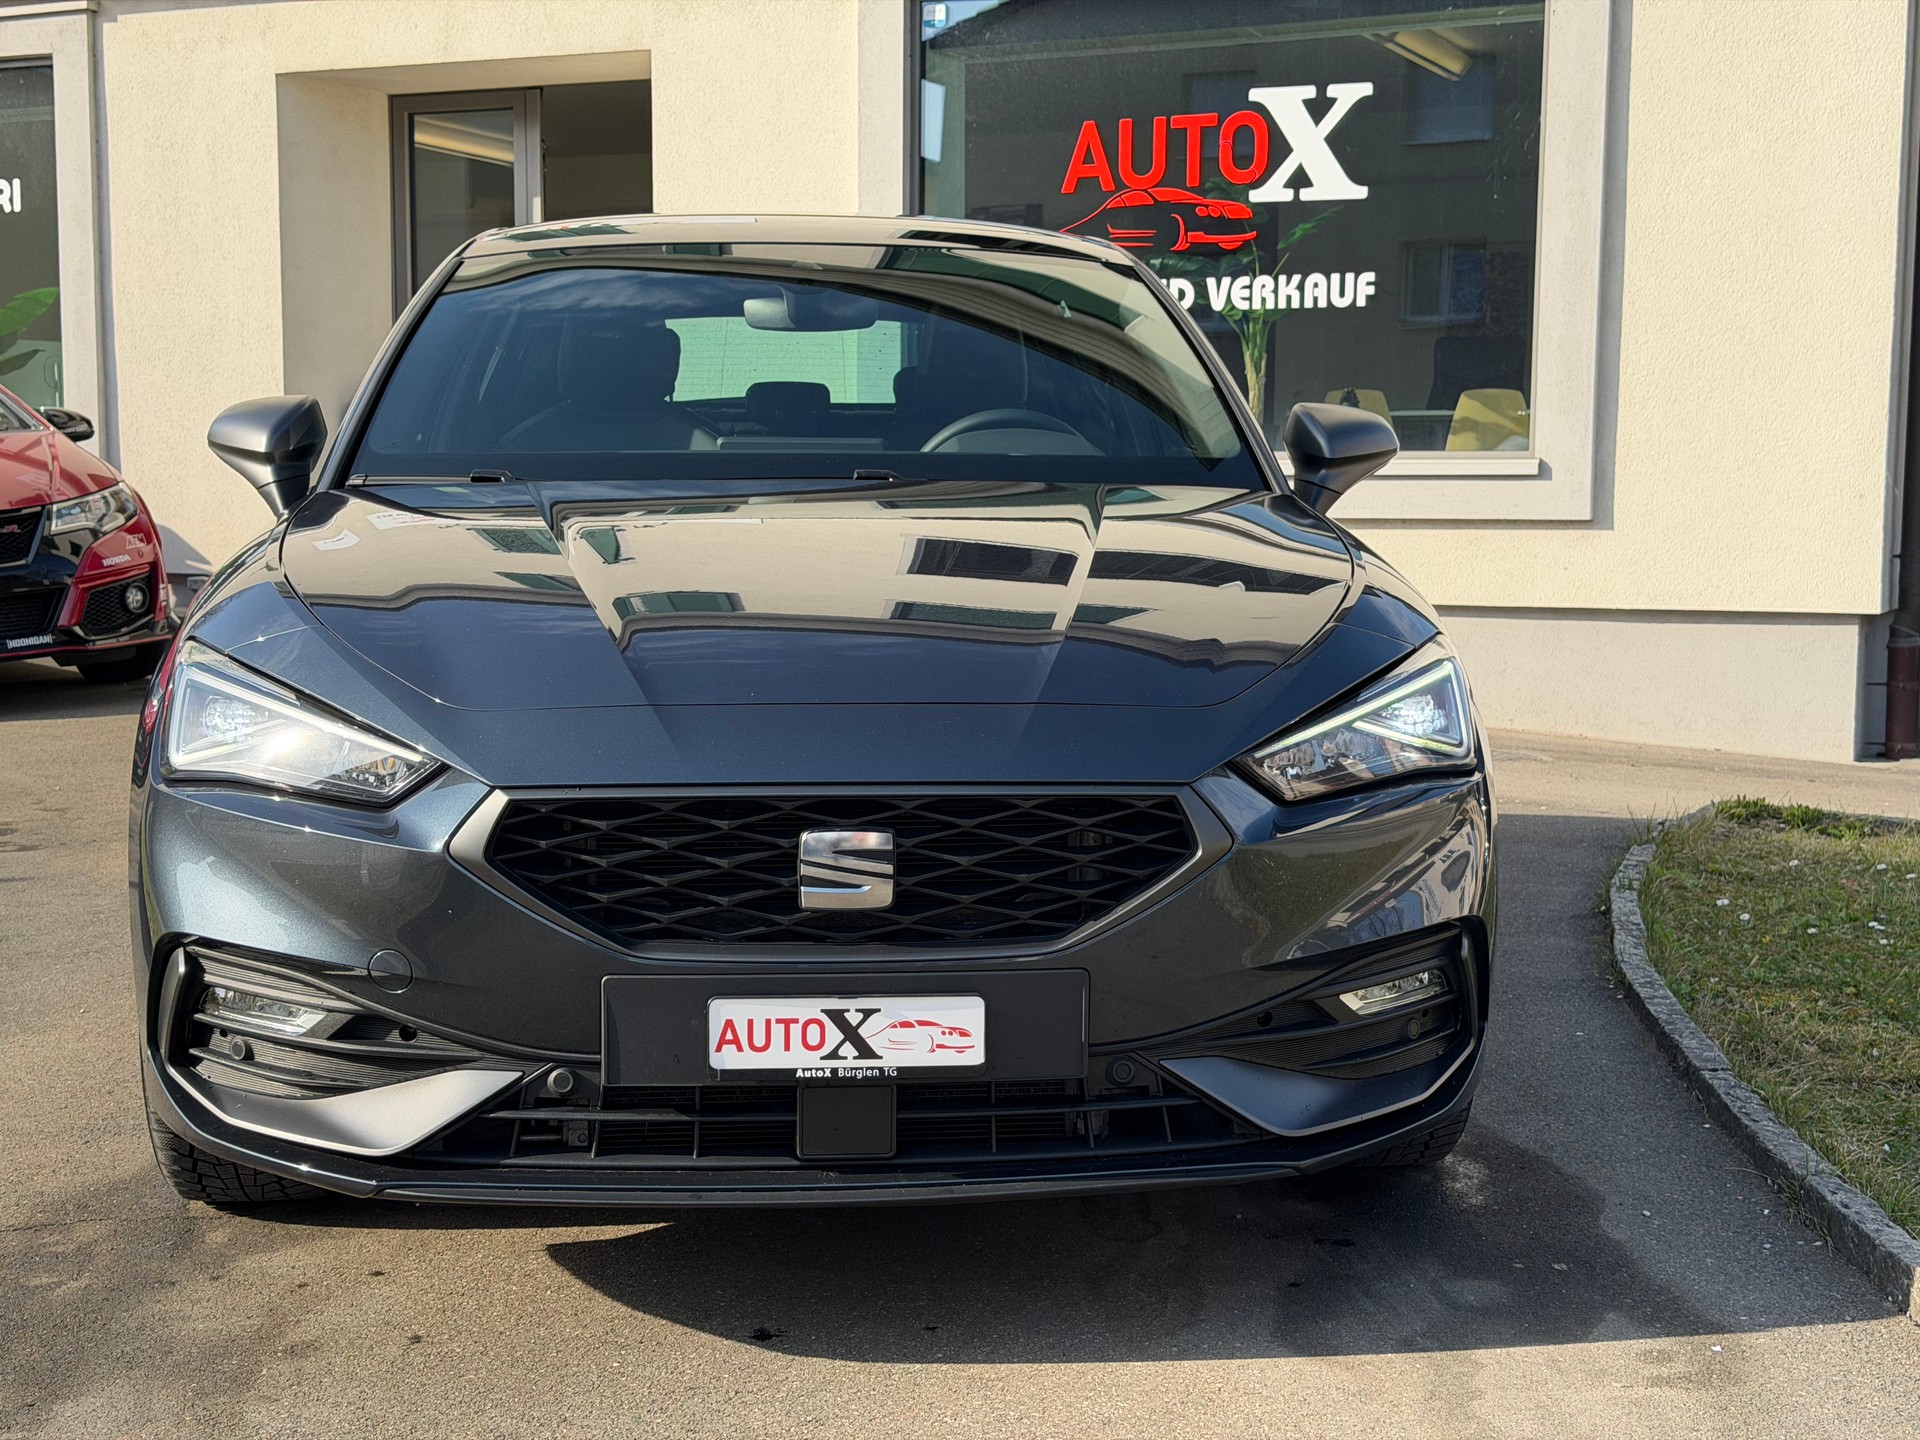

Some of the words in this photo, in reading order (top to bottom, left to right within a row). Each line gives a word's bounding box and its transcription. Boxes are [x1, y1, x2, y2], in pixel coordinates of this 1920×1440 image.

[1205, 271, 1376, 312] VERKAUF
[102, 553, 132, 567] HONDA
[796, 1068, 832, 1078] AutoX
[838, 1067, 880, 1079] Bürglen
[883, 1067, 898, 1077] TG
